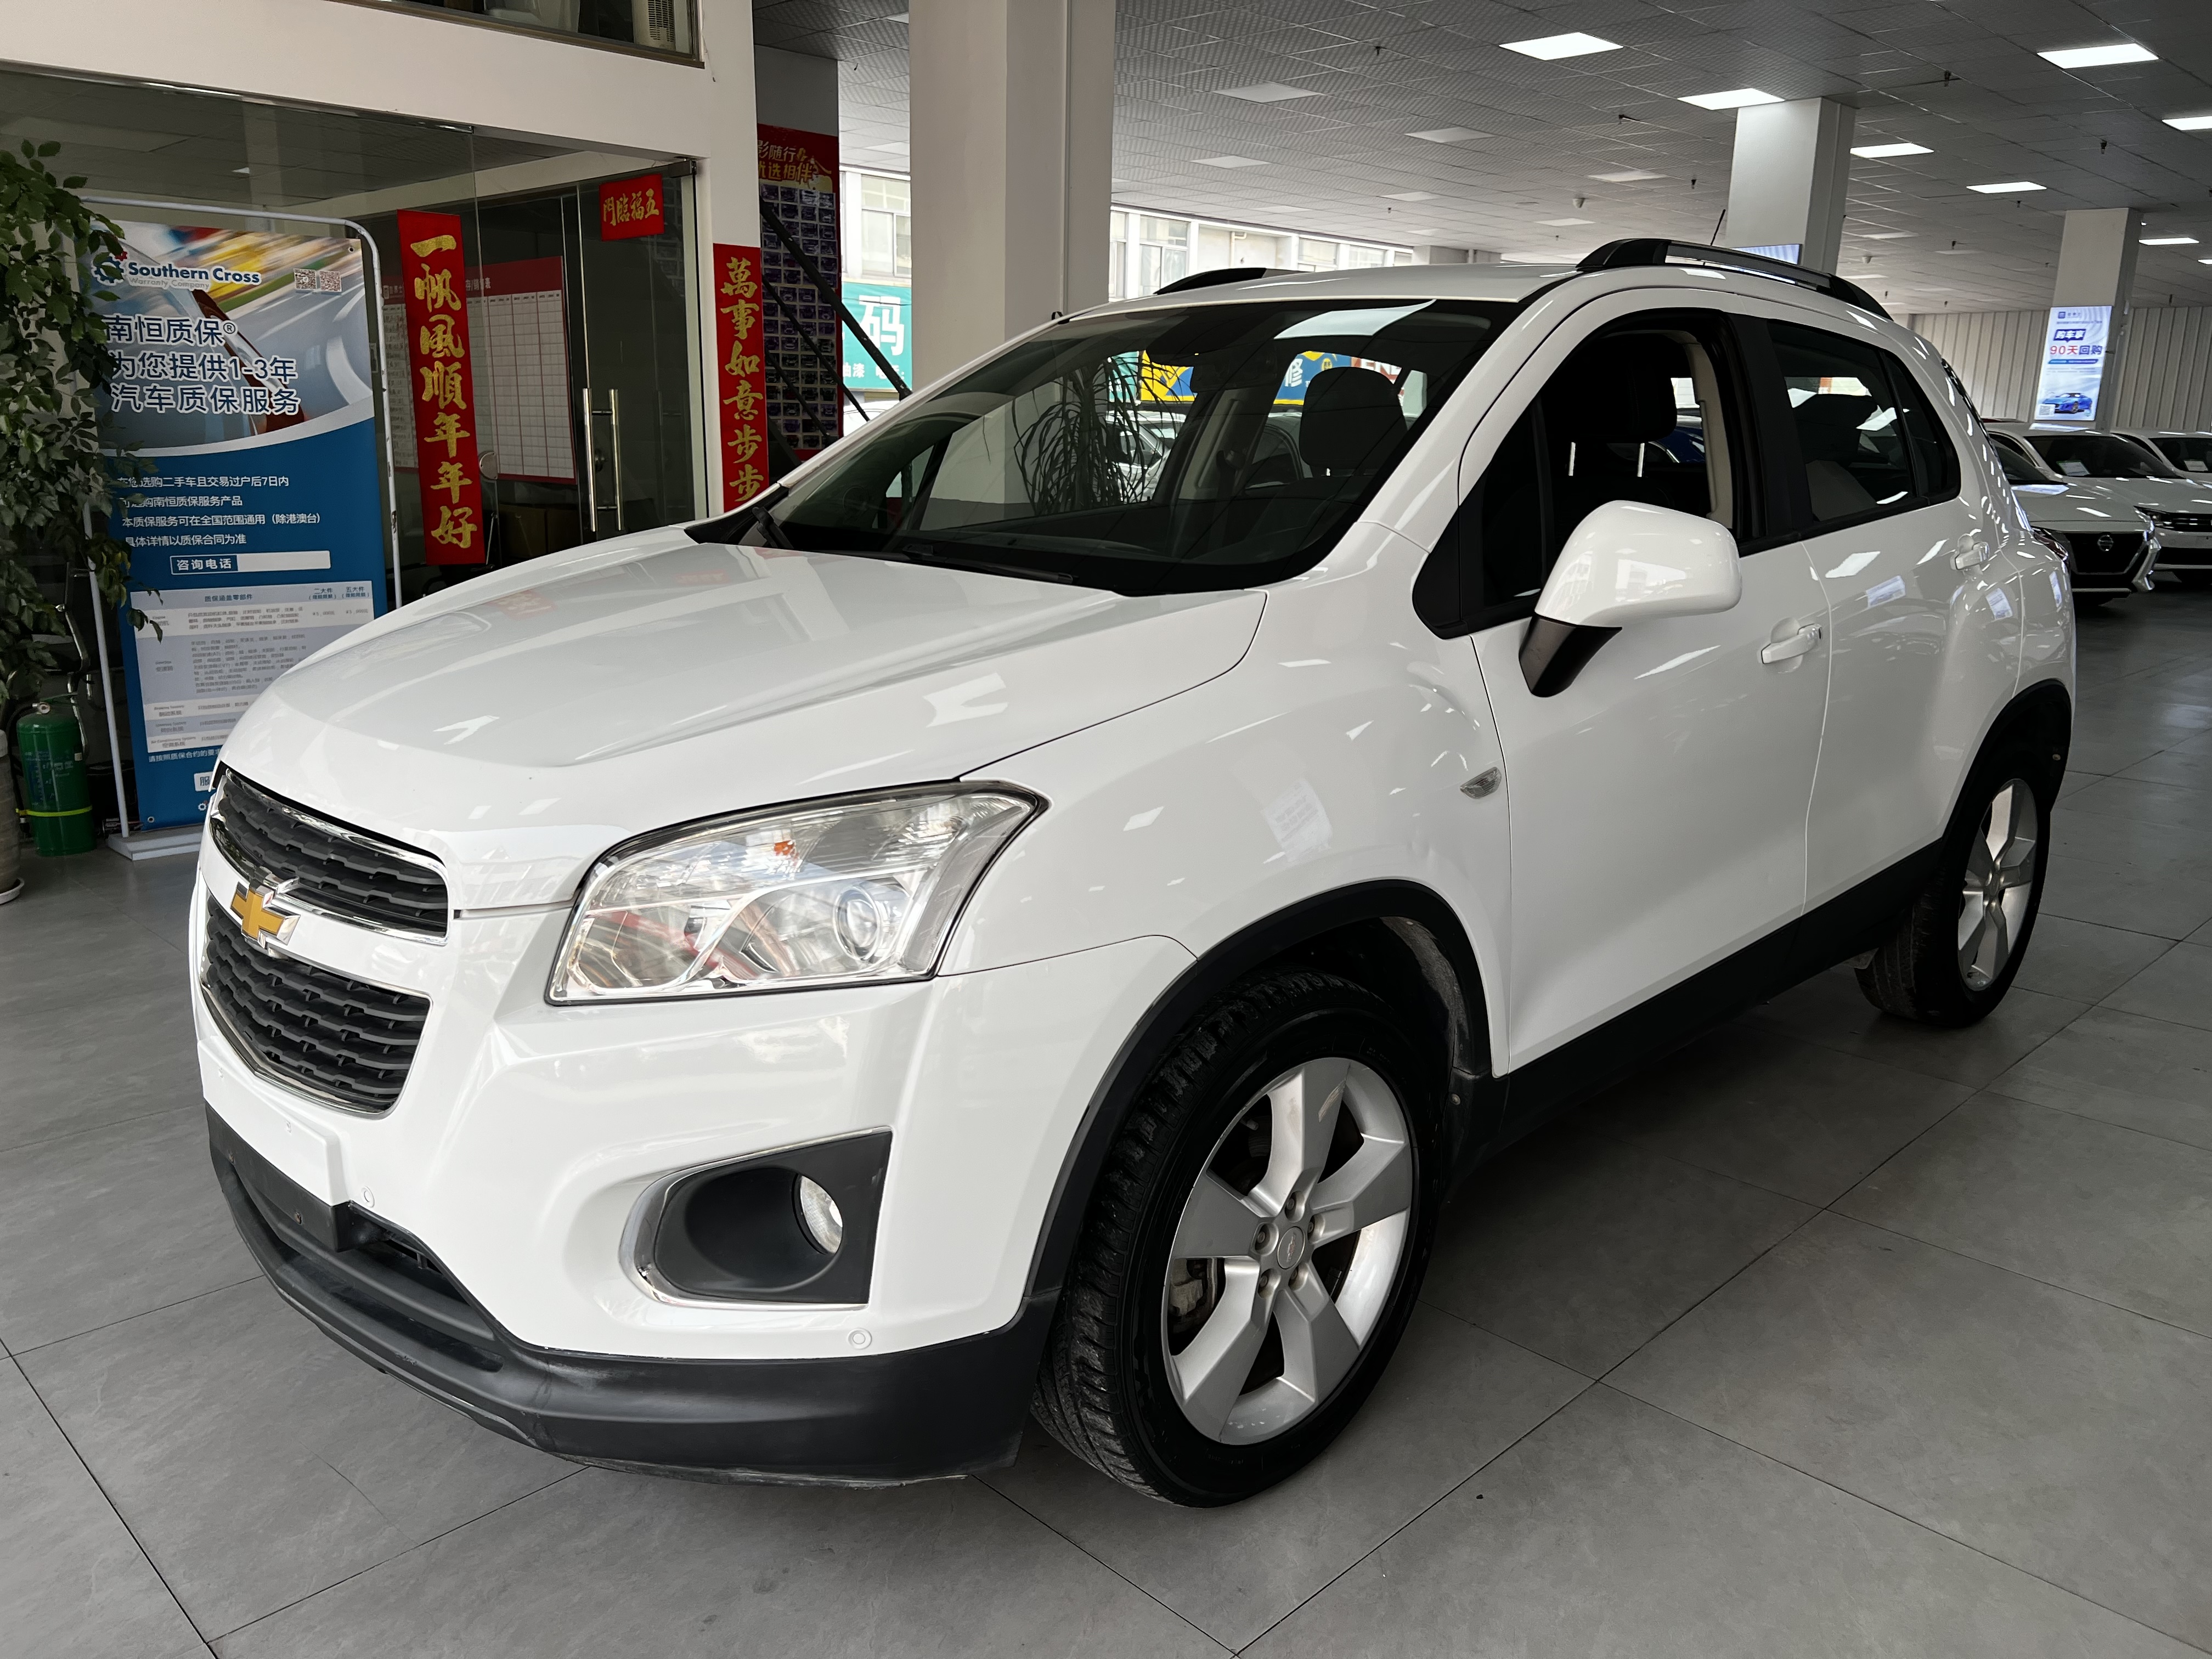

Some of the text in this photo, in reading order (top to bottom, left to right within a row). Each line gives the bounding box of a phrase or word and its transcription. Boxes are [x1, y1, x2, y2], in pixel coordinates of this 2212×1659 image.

[128, 262, 260, 283] Southern Cross
[129, 278, 210, 290] Warranty Company
[859, 295, 905, 356] 码
[2050, 345, 2103, 356] 90天回购
[112, 350, 297, 382] 为您提供1-3年
[111, 384, 300, 414] 汽车质保服务
[176, 557, 232, 571] 咨询电话
